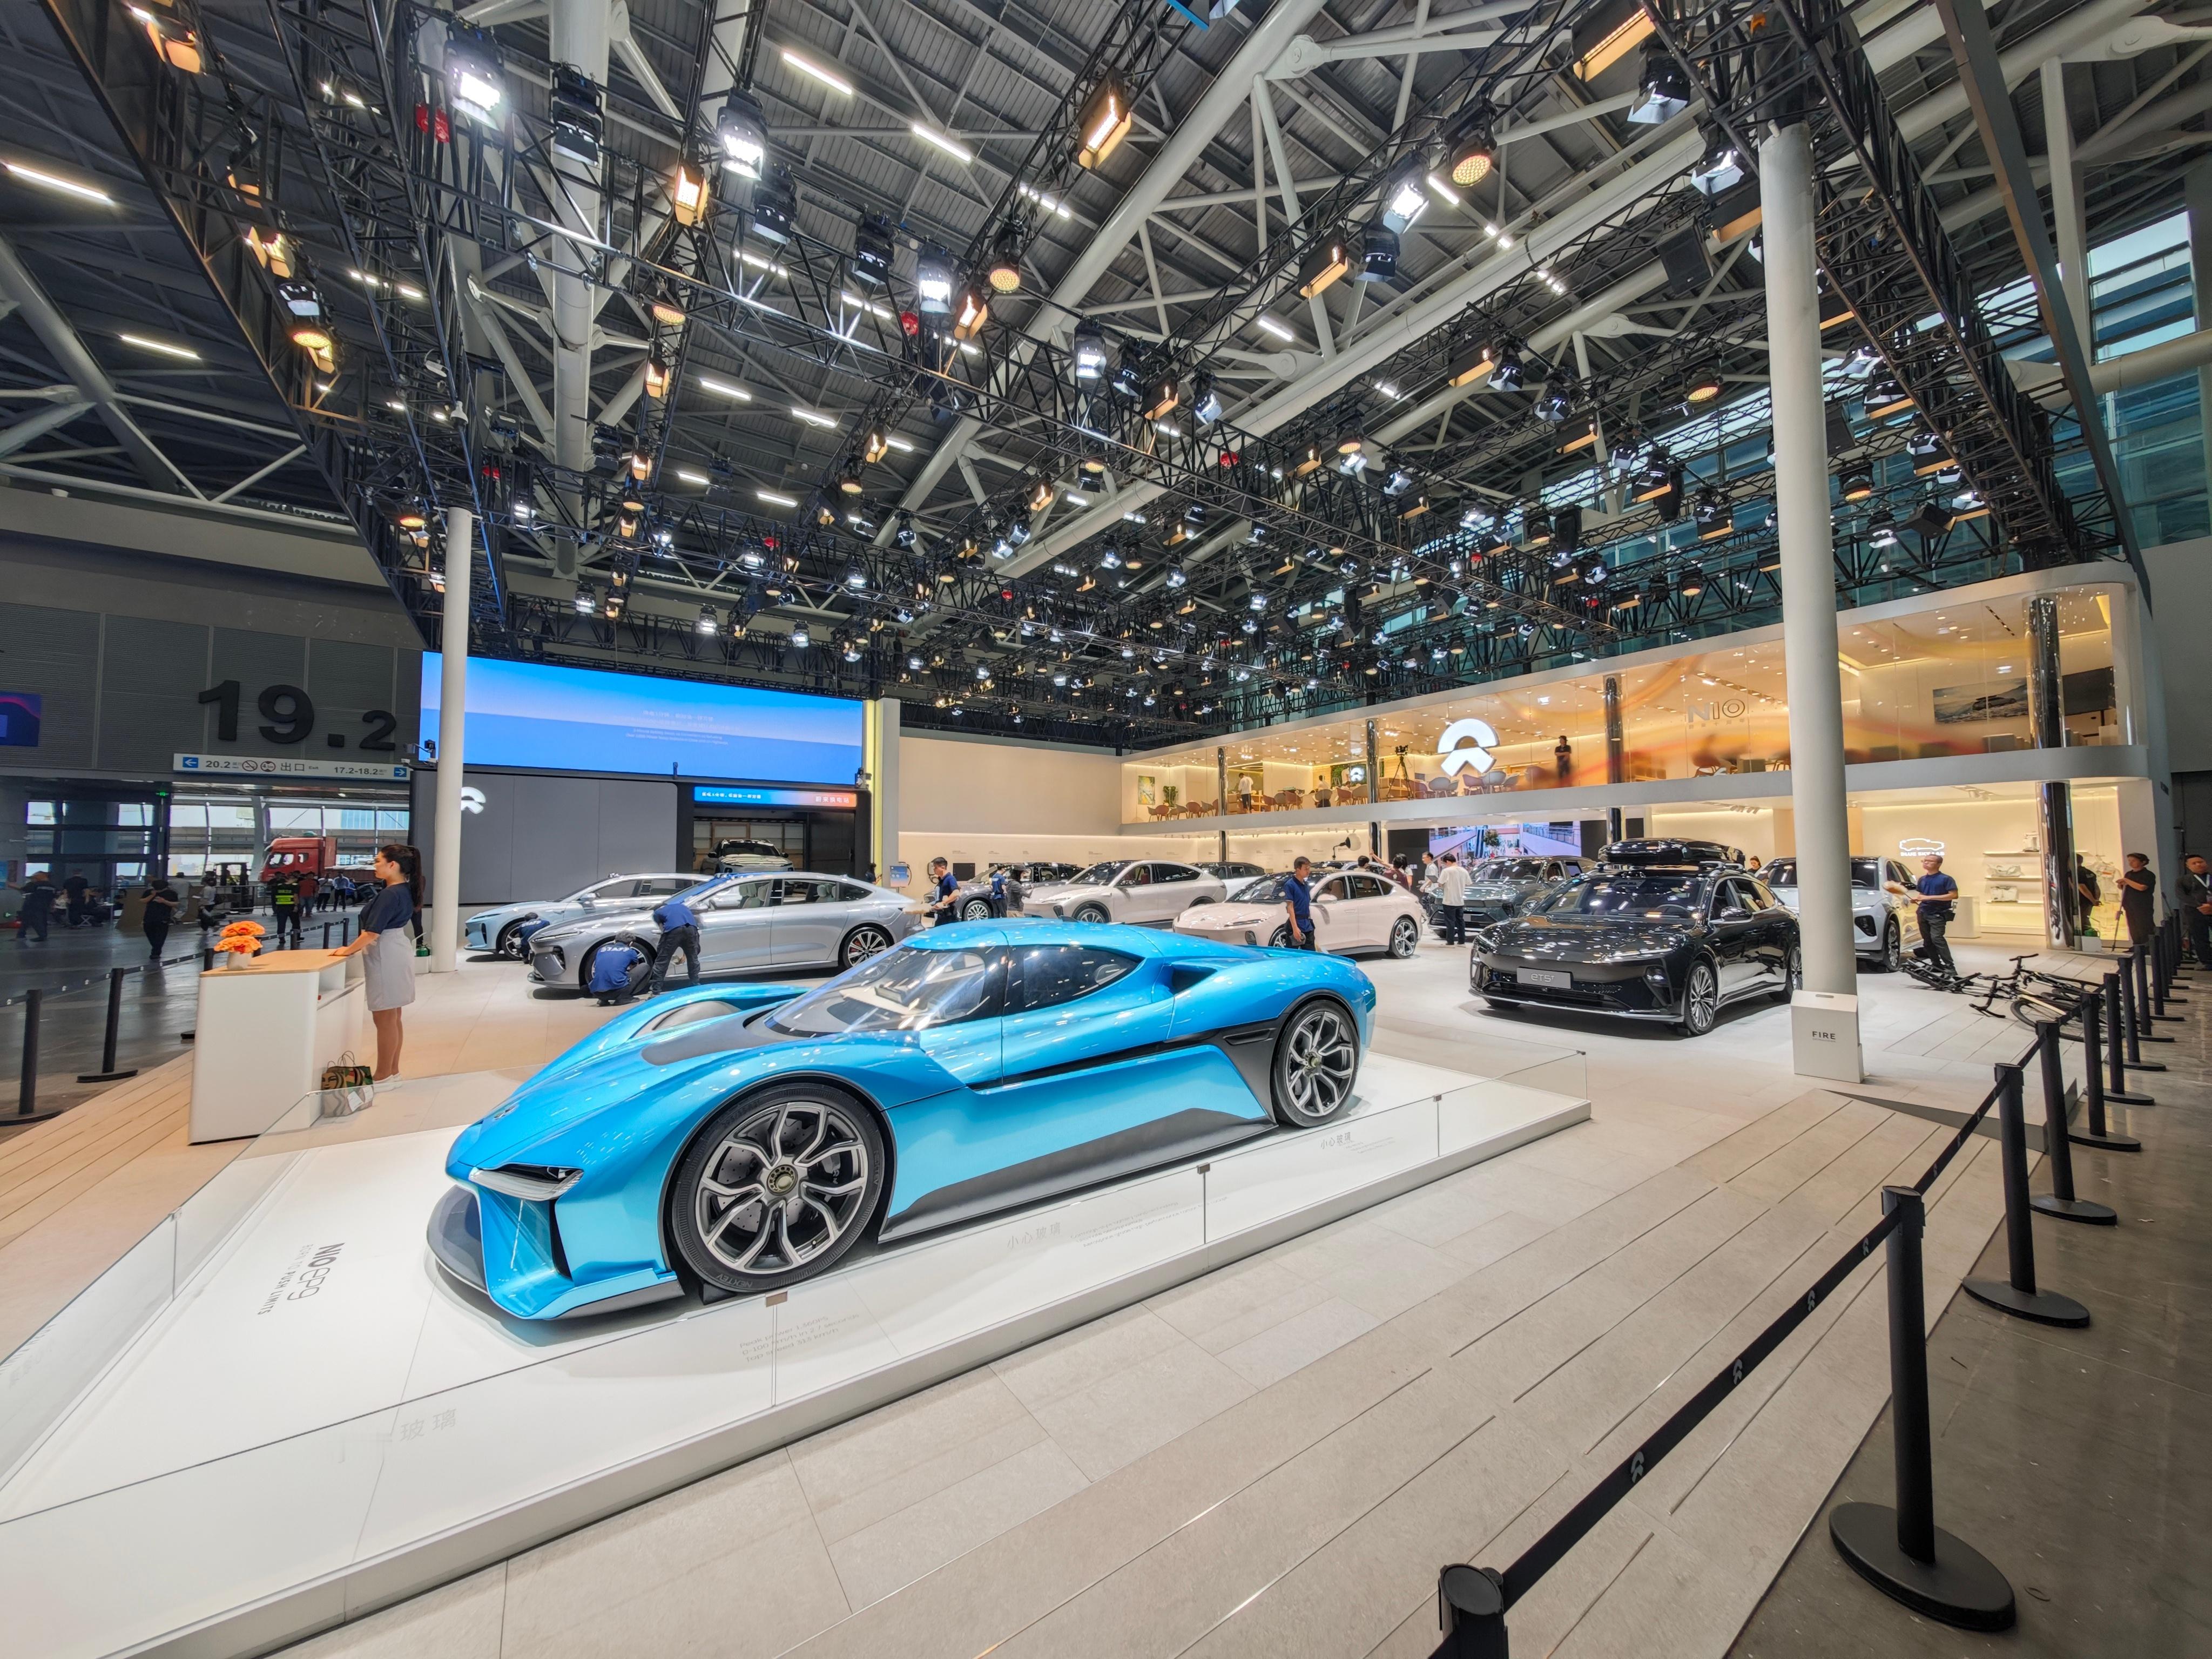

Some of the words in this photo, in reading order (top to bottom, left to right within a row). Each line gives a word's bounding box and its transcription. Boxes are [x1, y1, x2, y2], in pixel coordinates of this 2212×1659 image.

[198, 680, 396, 751] 19.2
[206, 760, 231, 768] 20.2
[281, 762, 305, 772] 出口
[334, 767, 378, 775] 17.2-18.2
[1812, 1031, 1836, 1040] FIRE
[1007, 1222, 1061, 1249] 小心玻璃
[307, 1242, 346, 1267] NIO
[274, 1270, 296, 1290] PUSH
[716, 1273, 753, 1289] NEXTEV
[257, 1290, 285, 1315] LIMITS
